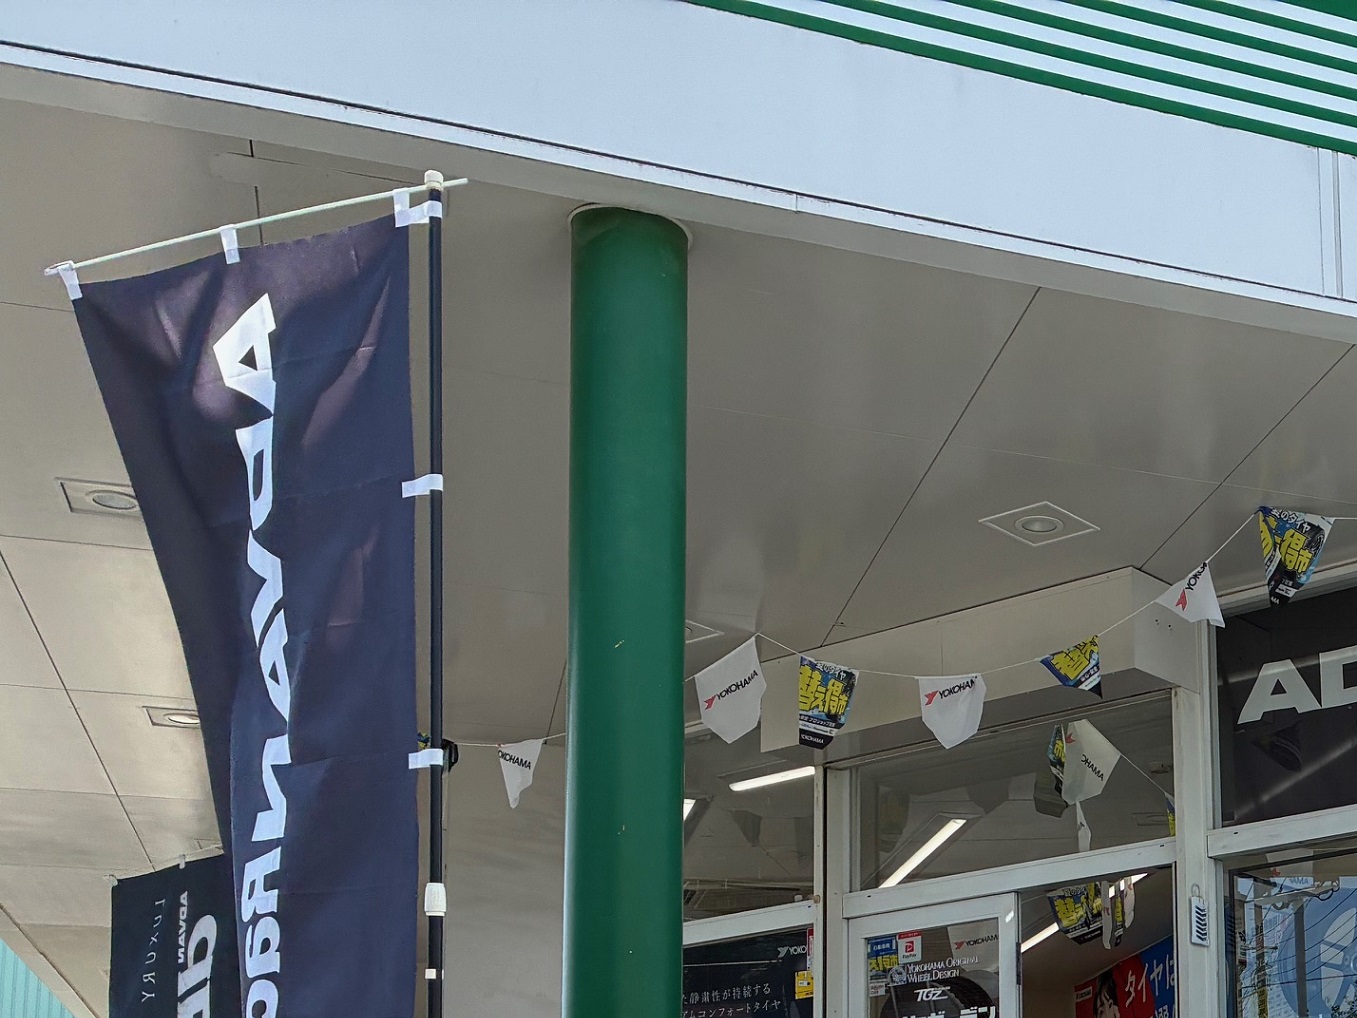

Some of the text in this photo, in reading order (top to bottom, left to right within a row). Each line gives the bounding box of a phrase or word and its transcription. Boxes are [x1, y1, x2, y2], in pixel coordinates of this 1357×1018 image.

[717, 669, 759, 700] YOKOHAMA
[938, 675, 978, 699] YOKOHA
[497, 749, 531, 770] OKOHAMA
[965, 934, 998, 947] YOKOHAM
[788, 945, 808, 956] YOKO
[906, 962, 945, 974] YOKOHAMA
[907, 969, 960, 984] WHEEL DESIGN
